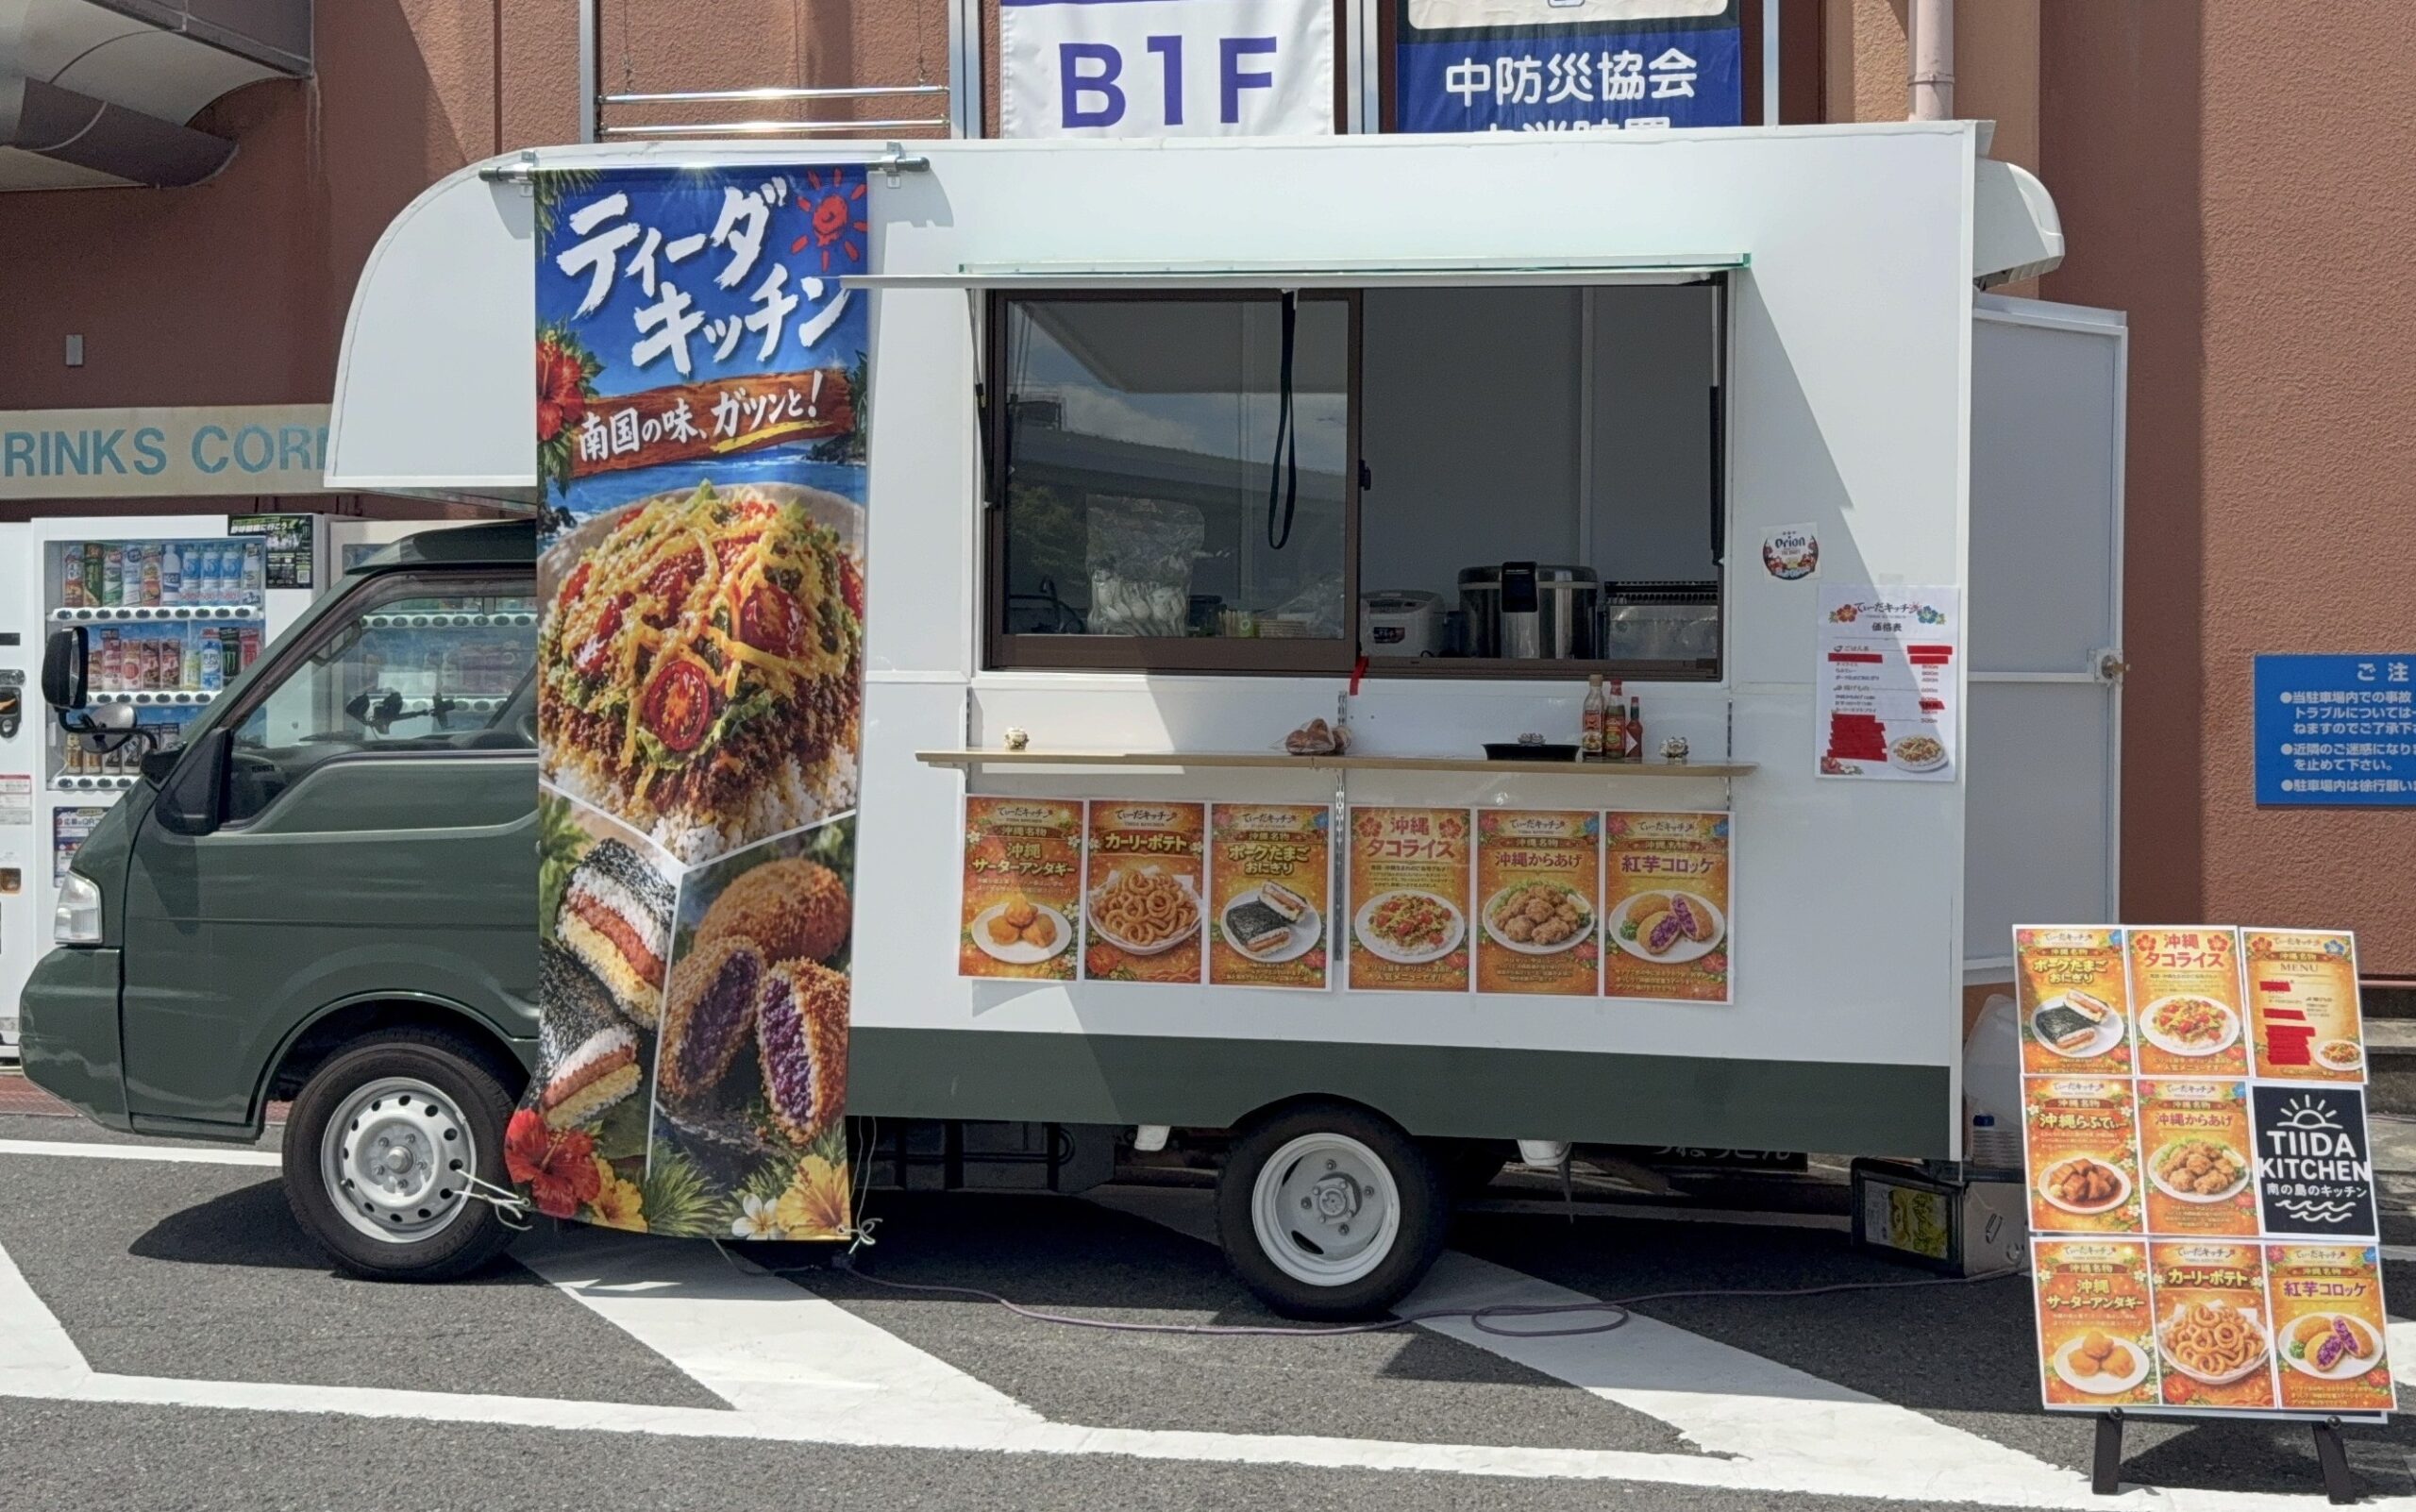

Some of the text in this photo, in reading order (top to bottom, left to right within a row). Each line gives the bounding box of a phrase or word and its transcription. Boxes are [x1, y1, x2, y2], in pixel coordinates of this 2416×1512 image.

[1060, 35, 1278, 129] B1F
[1445, 47, 1698, 108] 中防災協会
[555, 176, 788, 322] ティーダ
[630, 262, 851, 376] キッチン
[1775, 535, 1805, 548] Orion
[1871, 622, 1903, 632] 価格表
[2293, 722, 2416, 735] ねますのでご了承下
[2293, 743, 2416, 756] 近隣のご迷惑になり
[2293, 759, 2392, 772] を止めて下さい。
[1390, 815, 1430, 836] 沖縄
[1105, 832, 1187, 852] カーリーポテト
[1367, 838, 1456, 859] タコライス
[1006, 842, 1042, 860] 沖縄
[1494, 851, 1584, 868] 沖縄からあげ
[1245, 861, 1294, 876] おにぎり
[1620, 855, 1715, 874] 紅芋コロッケ
[2163, 933, 2200, 949] 沖縄
[2143, 951, 2225, 968] タコライス
[2280, 963, 2319, 972] MENU
[2049, 973, 2094, 984] おにぎり
[2039, 1113, 2127, 1130] 沖縄らふてぃー
[2155, 1113, 2234, 1127] 沖縄からあげ
[2266, 1130, 2357, 1158] TIIDA
[2257, 1157, 2372, 1182] KITCHEN
[2266, 1183, 2368, 1199] 南の島のキッチン
[2168, 1268, 2248, 1286] カーリーポテト
[2076, 1278, 2110, 1294] 沖縄
[2283, 1280, 2367, 1298] 紅芋コロッケ
